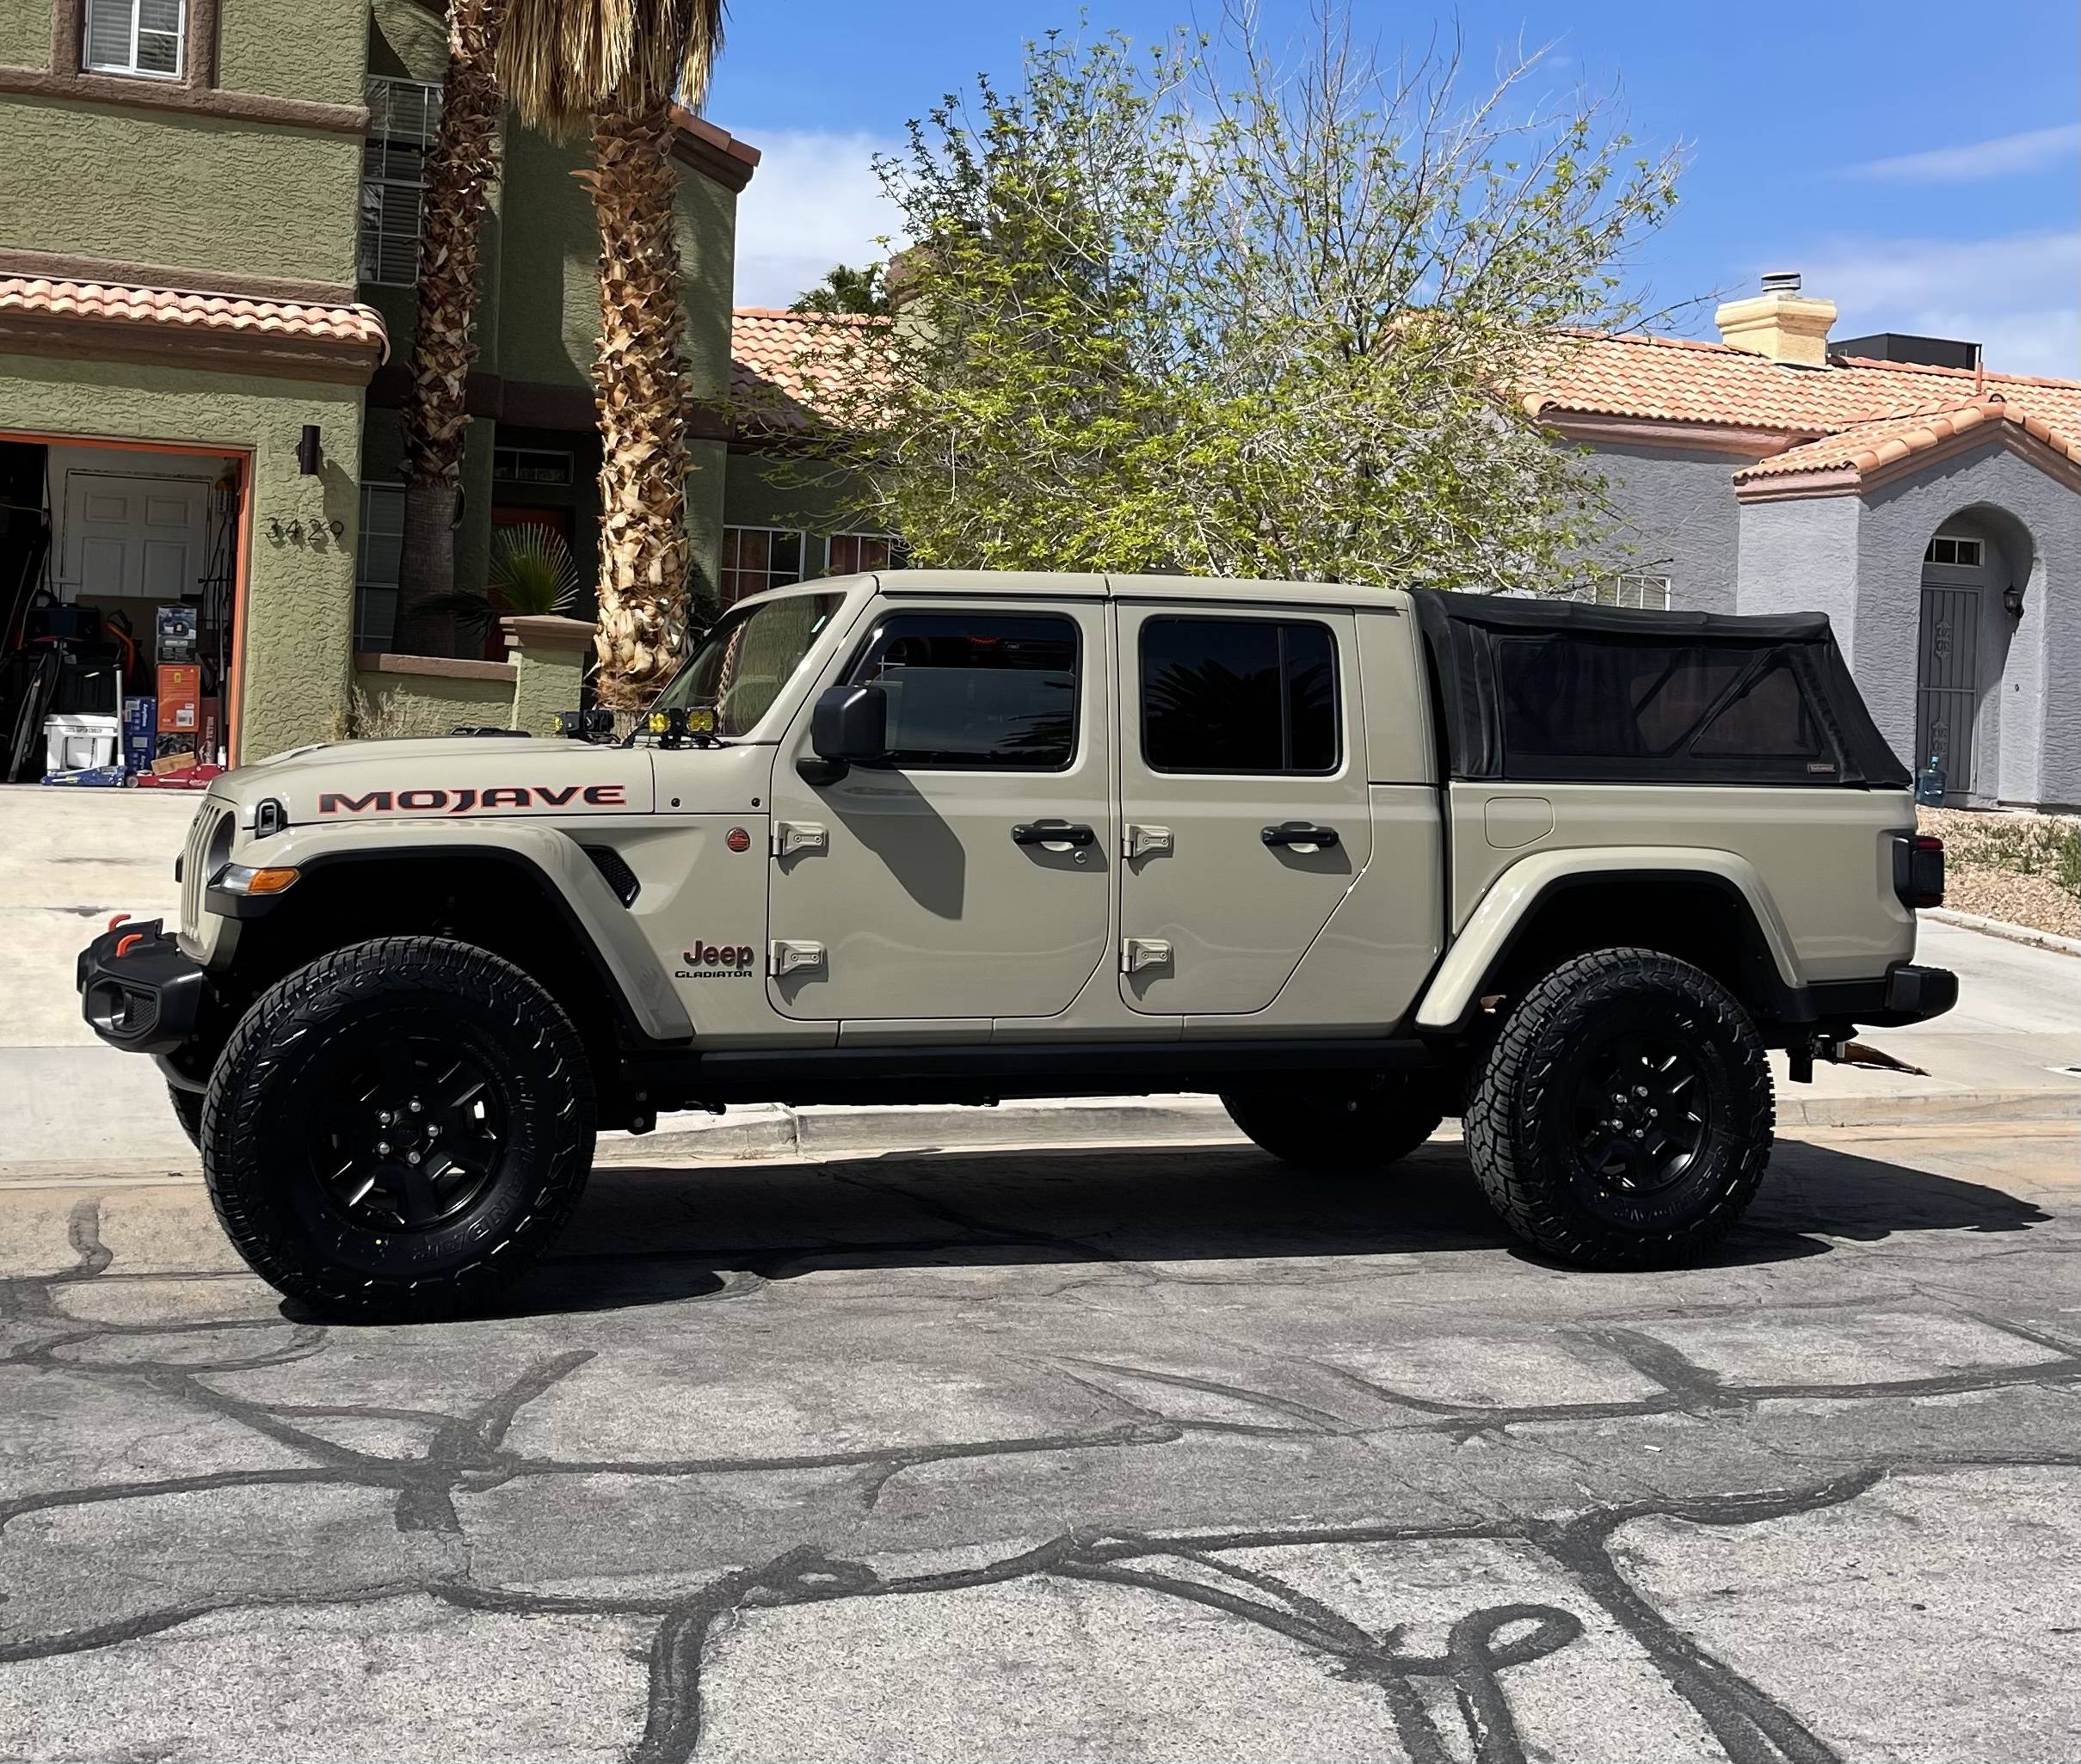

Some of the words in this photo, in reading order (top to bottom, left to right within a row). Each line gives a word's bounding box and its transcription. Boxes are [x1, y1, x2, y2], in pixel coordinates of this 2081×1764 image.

[265, 517, 344, 542] 3429
[318, 784, 627, 814] MOJAVE
[683, 939, 755, 969] Jeep
[674, 970, 754, 979] GLADIATOR
